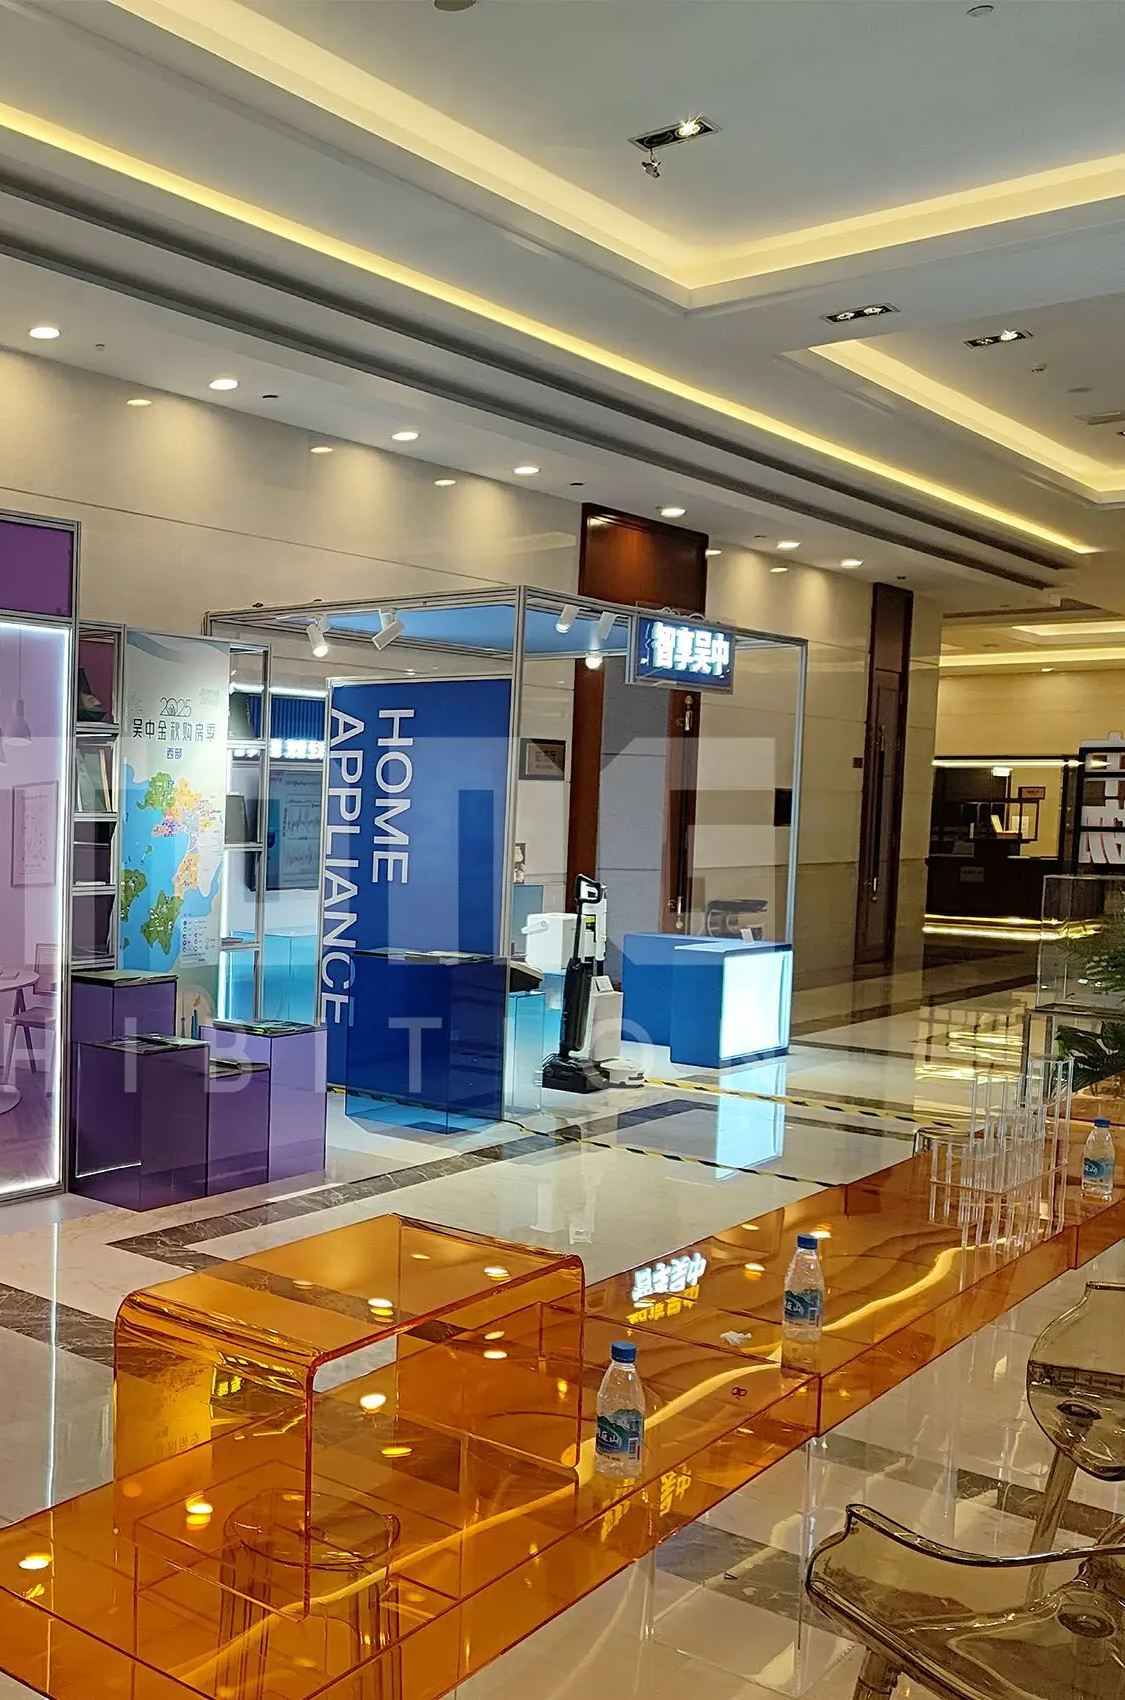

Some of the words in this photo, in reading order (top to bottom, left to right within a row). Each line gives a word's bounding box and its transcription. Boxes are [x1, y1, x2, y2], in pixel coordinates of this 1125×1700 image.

[132, 718, 216, 742] 吴中金秋购房季
[159, 696, 192, 718] 2025
[372, 709, 415, 884] HOME
[320, 708, 355, 1026] APPLIANCE
